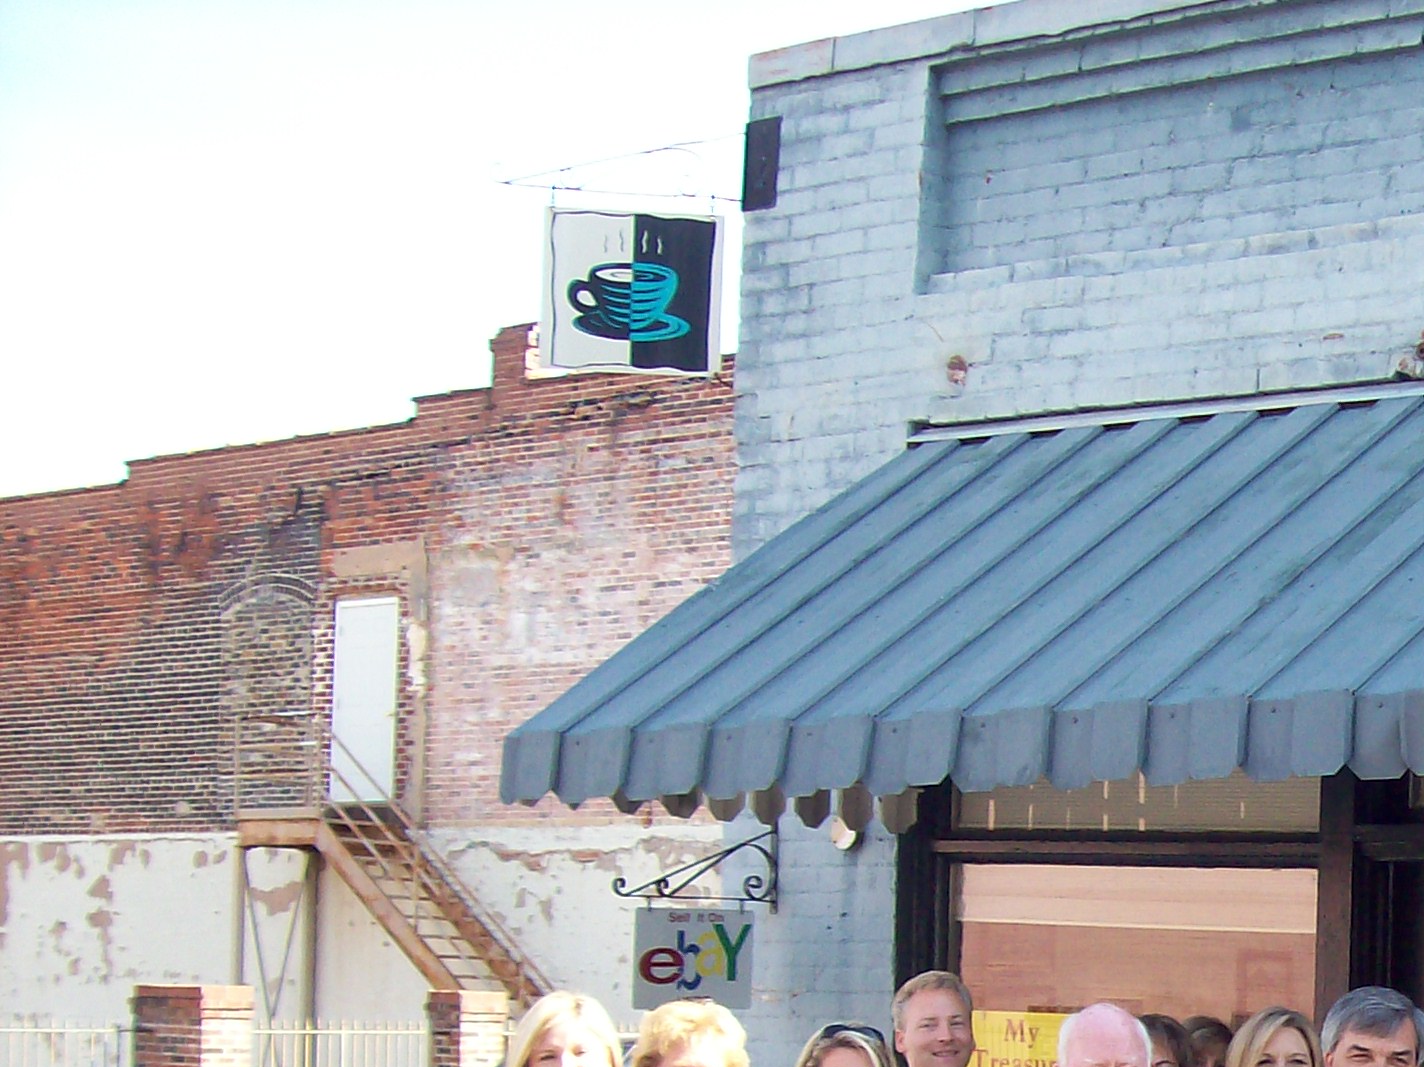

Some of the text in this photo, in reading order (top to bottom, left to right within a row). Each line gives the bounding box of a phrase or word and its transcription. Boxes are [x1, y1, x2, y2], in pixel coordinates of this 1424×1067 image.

[668, 912, 691, 923] Sell
[708, 912, 725, 923] On
[1004, 1018, 1040, 1048] My
